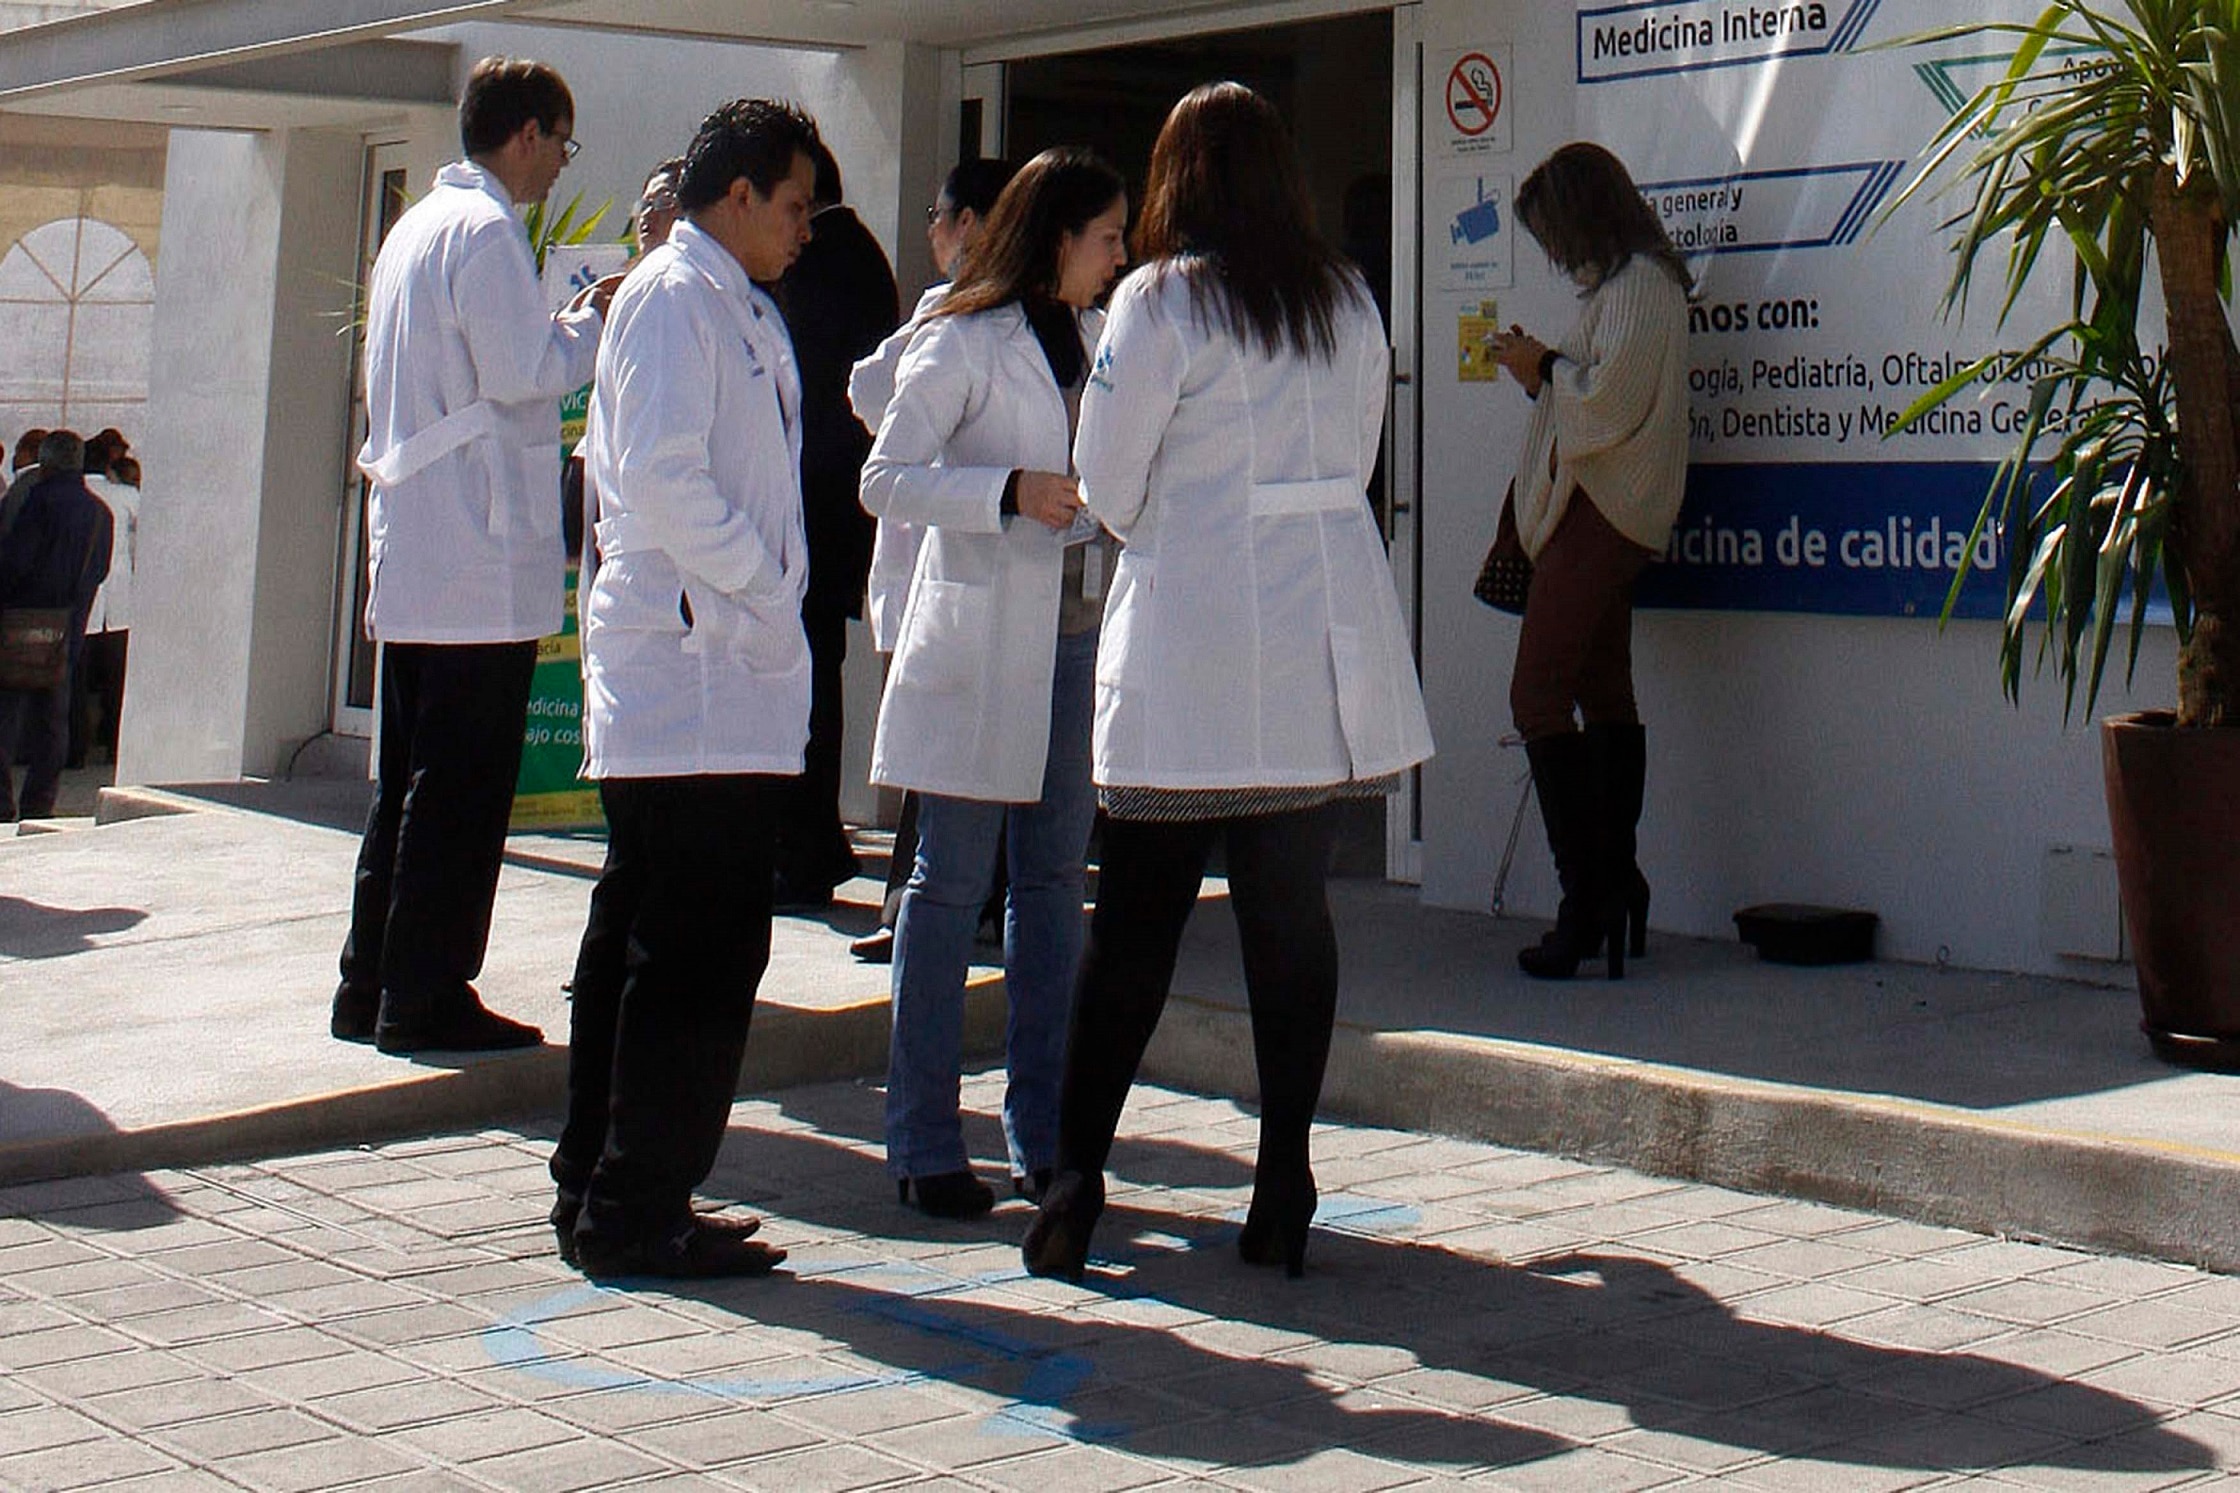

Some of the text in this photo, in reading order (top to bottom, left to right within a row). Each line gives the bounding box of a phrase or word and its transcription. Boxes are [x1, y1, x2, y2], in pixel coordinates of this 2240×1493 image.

[1593, 2, 1827, 60] Medicina Interna
[1662, 181, 1743, 218] general y
[1757, 299, 1819, 330] con:
[1689, 360, 1744, 398] ogía,
[1752, 353, 1874, 392] Pediatría,
[1723, 405, 1831, 439] Dentista
[1837, 411, 1853, 443] y
[1671, 514, 1998, 571] icina de calidad
[526, 725, 582, 745] ajo cos
